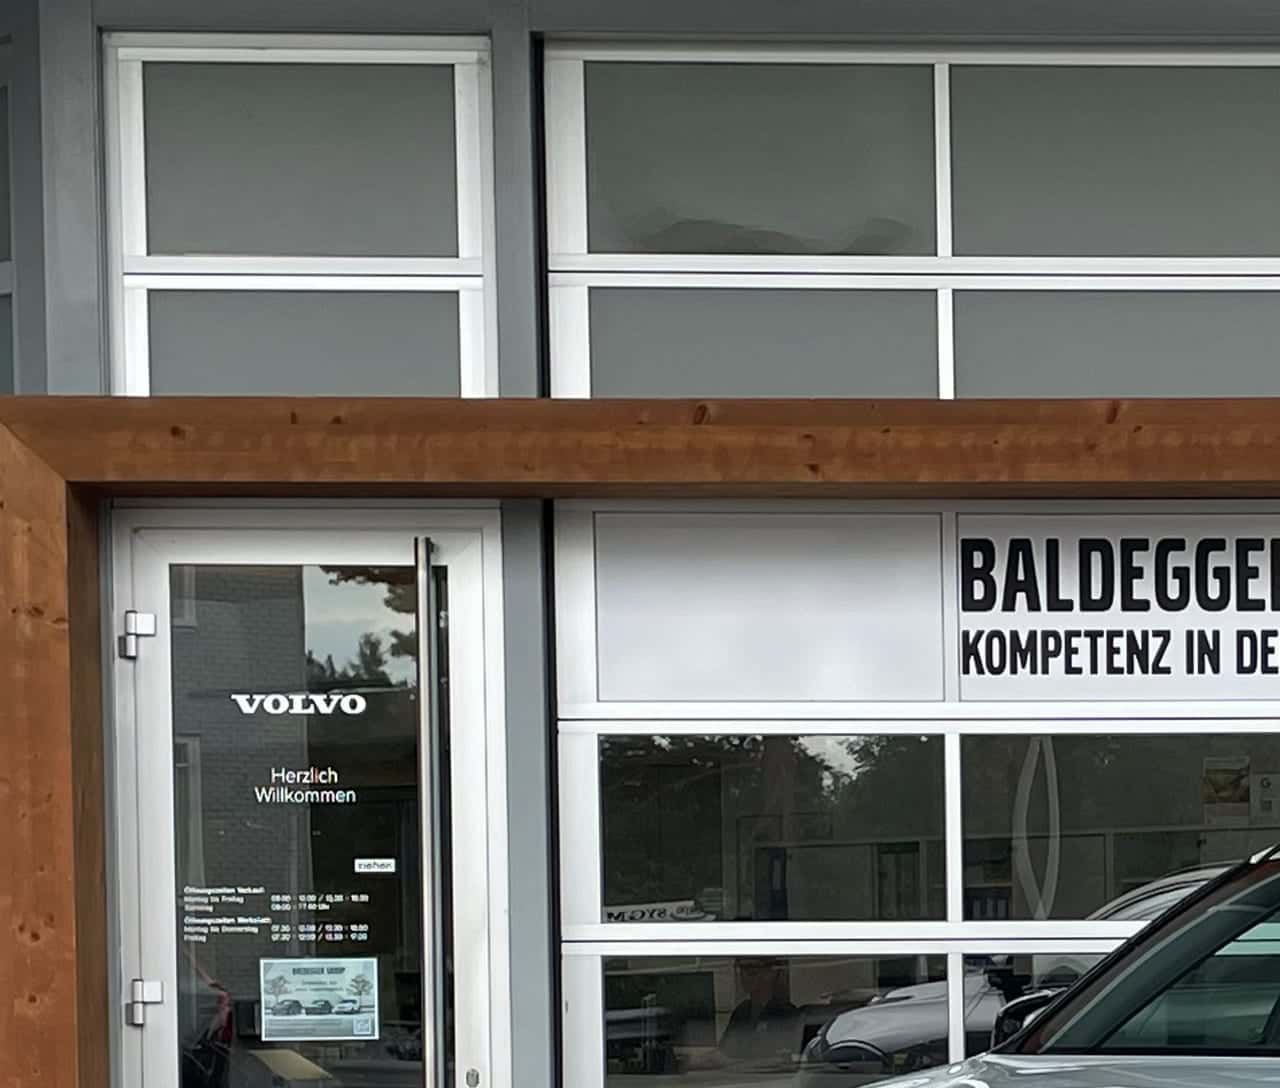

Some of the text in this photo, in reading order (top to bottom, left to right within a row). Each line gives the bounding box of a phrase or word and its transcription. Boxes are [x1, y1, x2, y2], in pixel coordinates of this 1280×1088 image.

[961, 629, 1171, 675] KOMPETENZ
[1185, 629, 1220, 674] IN
[231, 694, 367, 714] VOLVO
[271, 767, 338, 784] Herzlich
[254, 786, 357, 803] Willkommen
